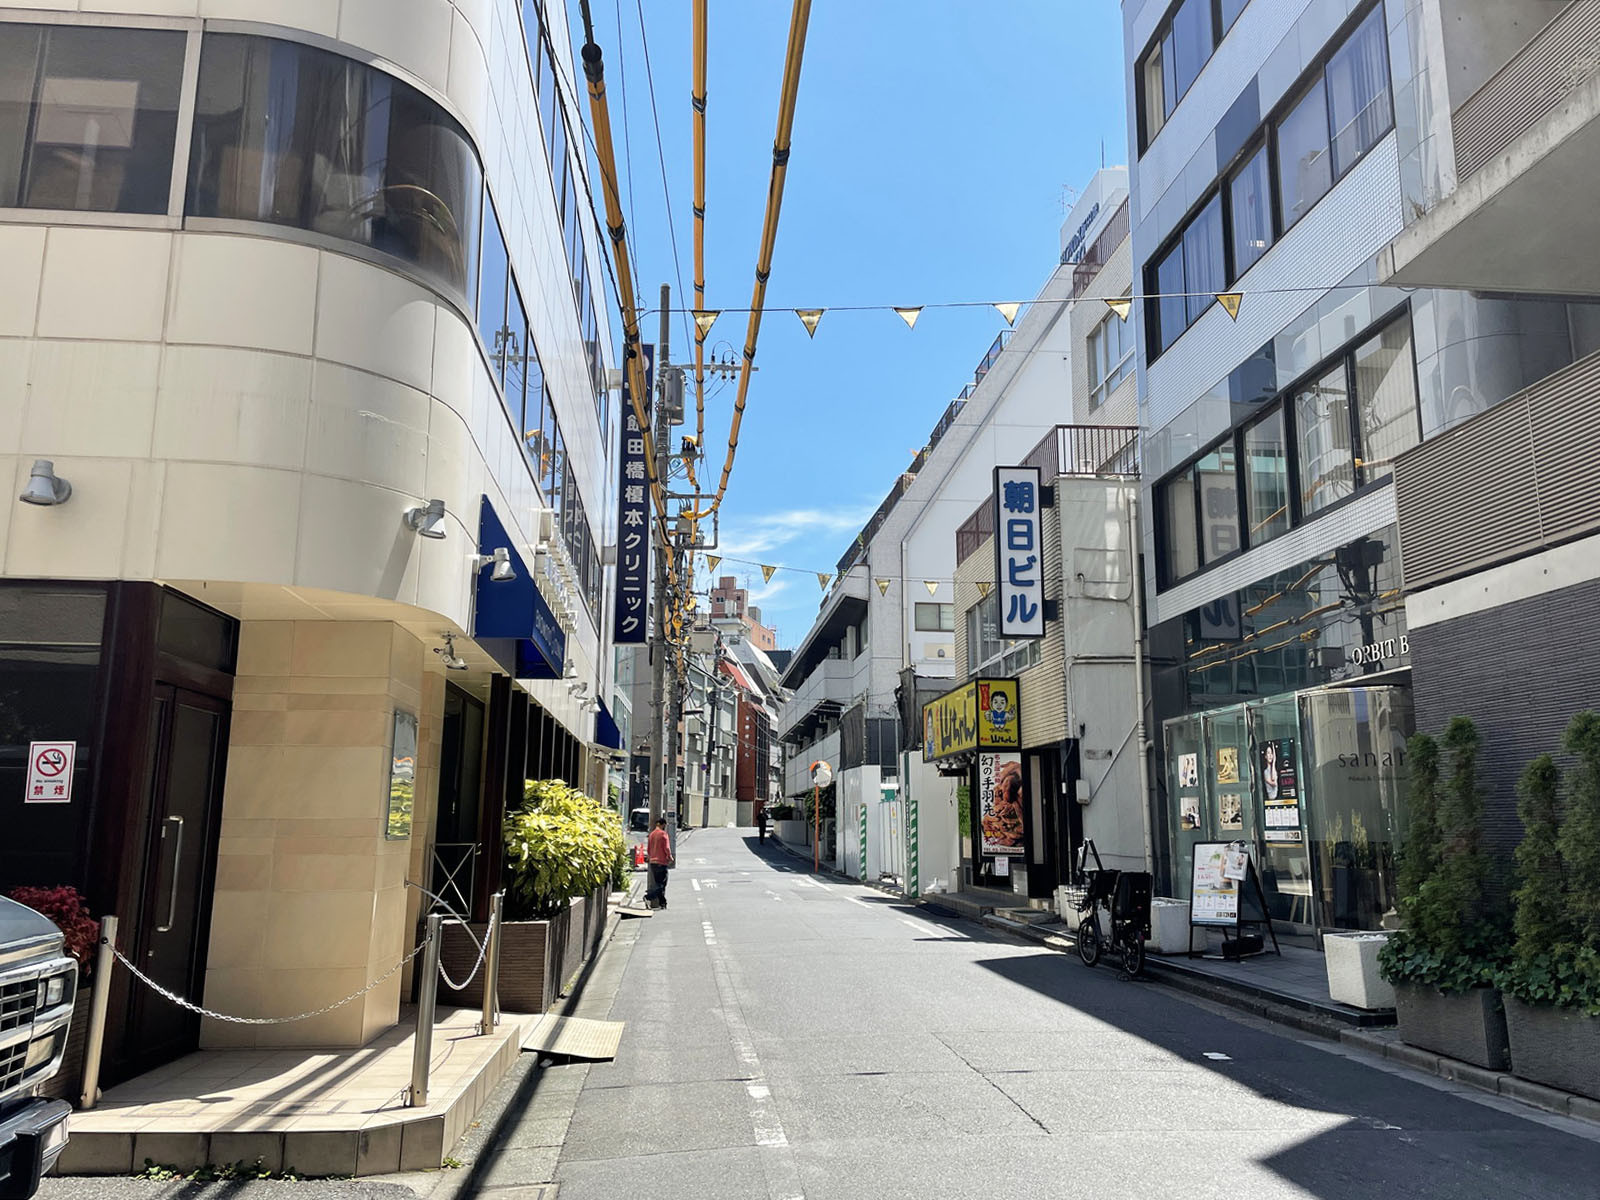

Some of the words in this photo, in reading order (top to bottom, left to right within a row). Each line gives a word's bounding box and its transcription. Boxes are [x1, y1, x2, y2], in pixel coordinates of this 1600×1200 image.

[1003, 480, 1038, 623] 朝日ビル
[1352, 638, 1395, 666] ORBIT
[33, 785, 64, 795] 禁煙
[981, 754, 996, 817] 幻の手羽先
